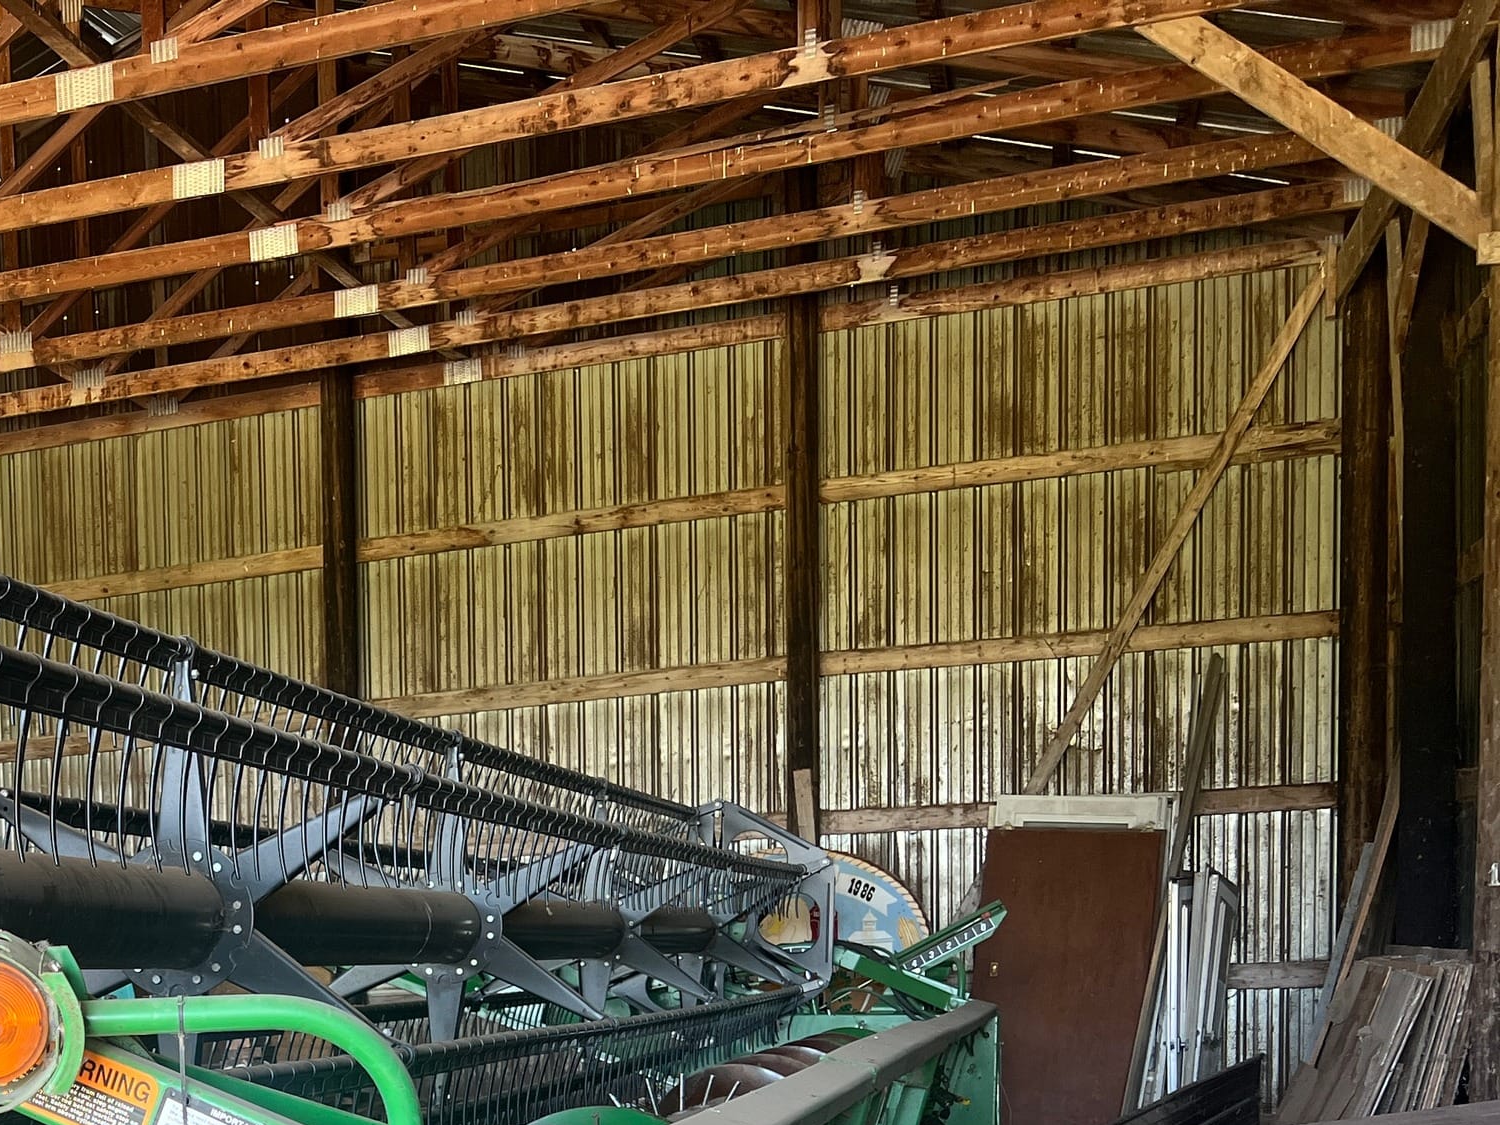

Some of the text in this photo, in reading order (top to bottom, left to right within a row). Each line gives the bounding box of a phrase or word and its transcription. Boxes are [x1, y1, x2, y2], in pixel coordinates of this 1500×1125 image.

[848, 878, 875, 901] 1986
[911, 923, 987, 968] 4 3 2 1 0
[79, 1058, 151, 1104] RNING
